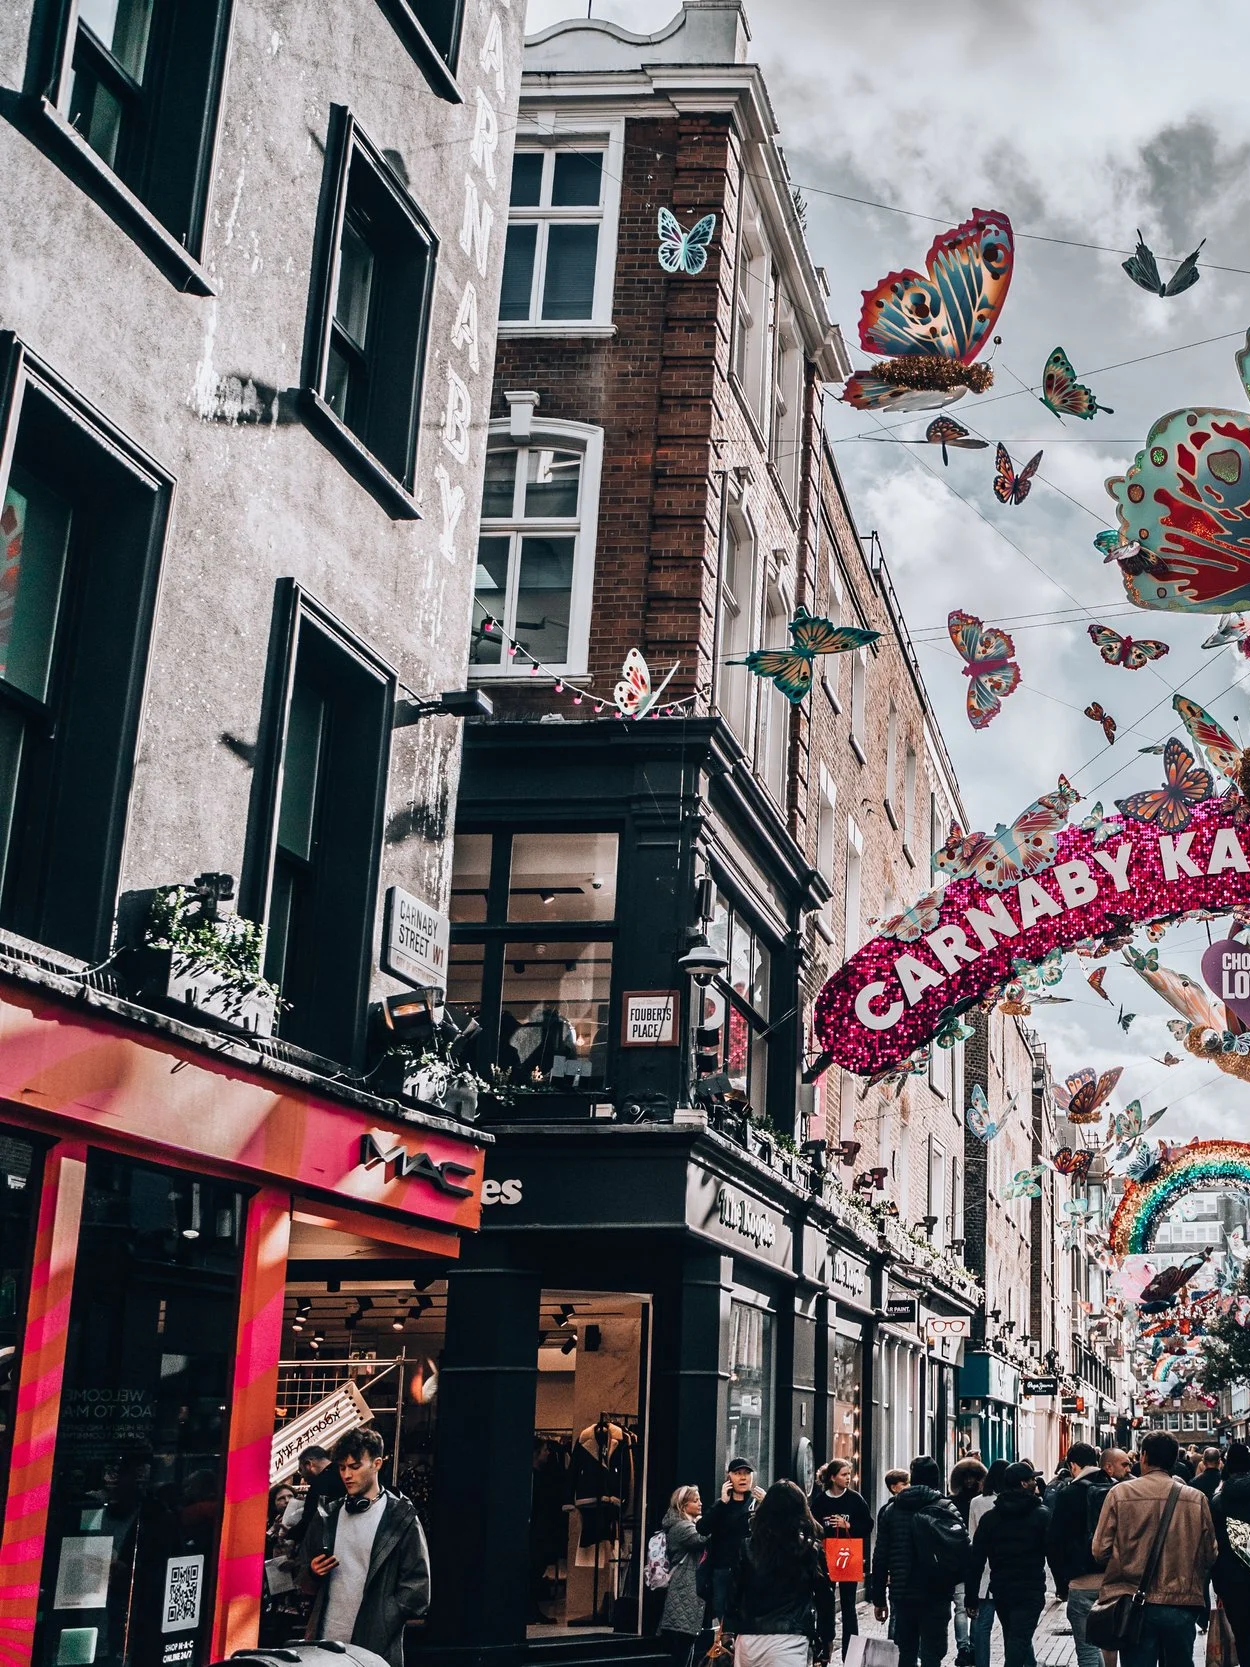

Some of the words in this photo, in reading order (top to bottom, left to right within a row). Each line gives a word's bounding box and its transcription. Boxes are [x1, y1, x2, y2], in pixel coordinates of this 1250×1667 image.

[433, 0, 510, 564] ARNABY
[400, 900, 438, 939] CARNABY
[853, 841, 1134, 1031] CARNABY
[399, 924, 429, 958] STREET
[432, 944, 444, 969] W1
[632, 1024, 659, 1038] PLACE
[360, 1133, 476, 1197] MAC
[481, 1178, 523, 1205] es
[162, 1652, 181, 1663] ONLINE
[180, 1650, 193, 1660] 24/7
[165, 1643, 178, 1653] SHOP
